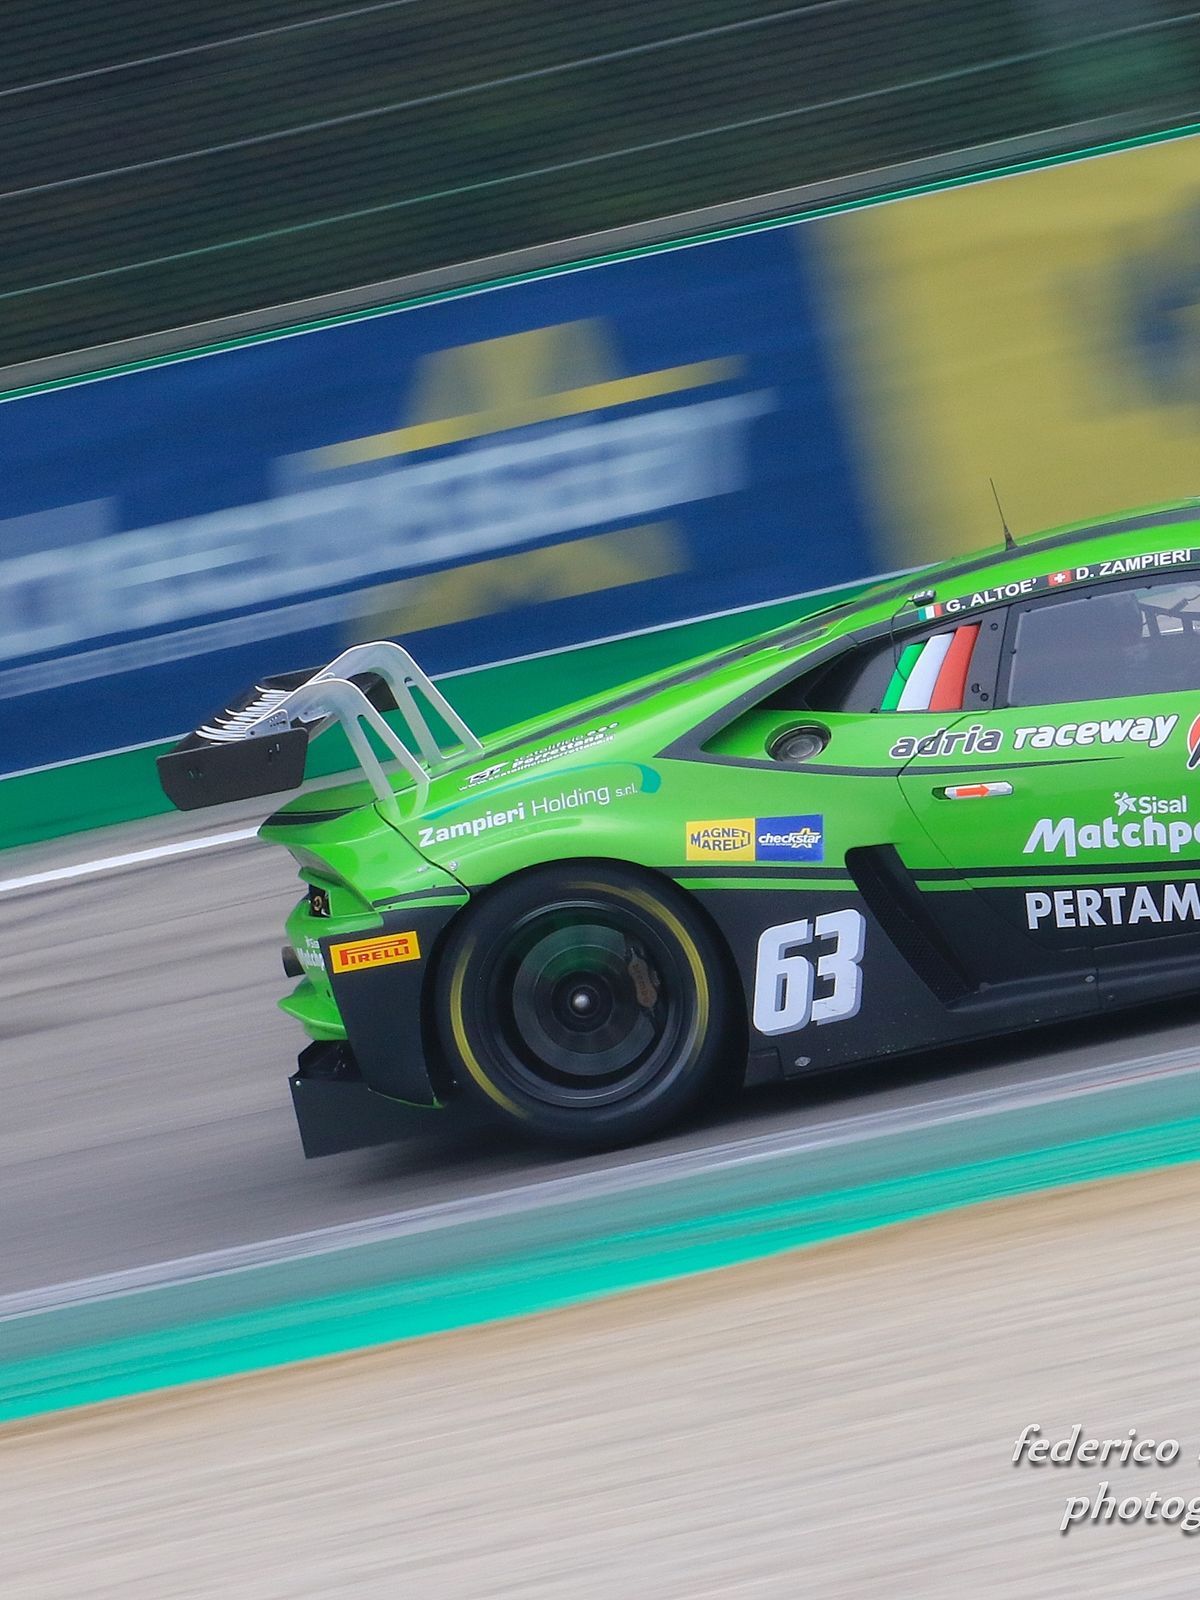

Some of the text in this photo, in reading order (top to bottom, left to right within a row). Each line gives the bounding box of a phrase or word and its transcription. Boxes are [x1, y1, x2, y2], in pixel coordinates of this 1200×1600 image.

[1075, 549, 1191, 581] D. ZAMPIERI
[946, 599, 967, 613] G.
[889, 713, 1180, 760] adria raceway
[418, 802, 525, 848] Zampieri
[532, 786, 610, 816] Holding
[1138, 795, 1188, 815] Sisal
[758, 832, 822, 844] checkstar
[339, 938, 410, 966] PIRELLI
[753, 908, 866, 1037] 63
